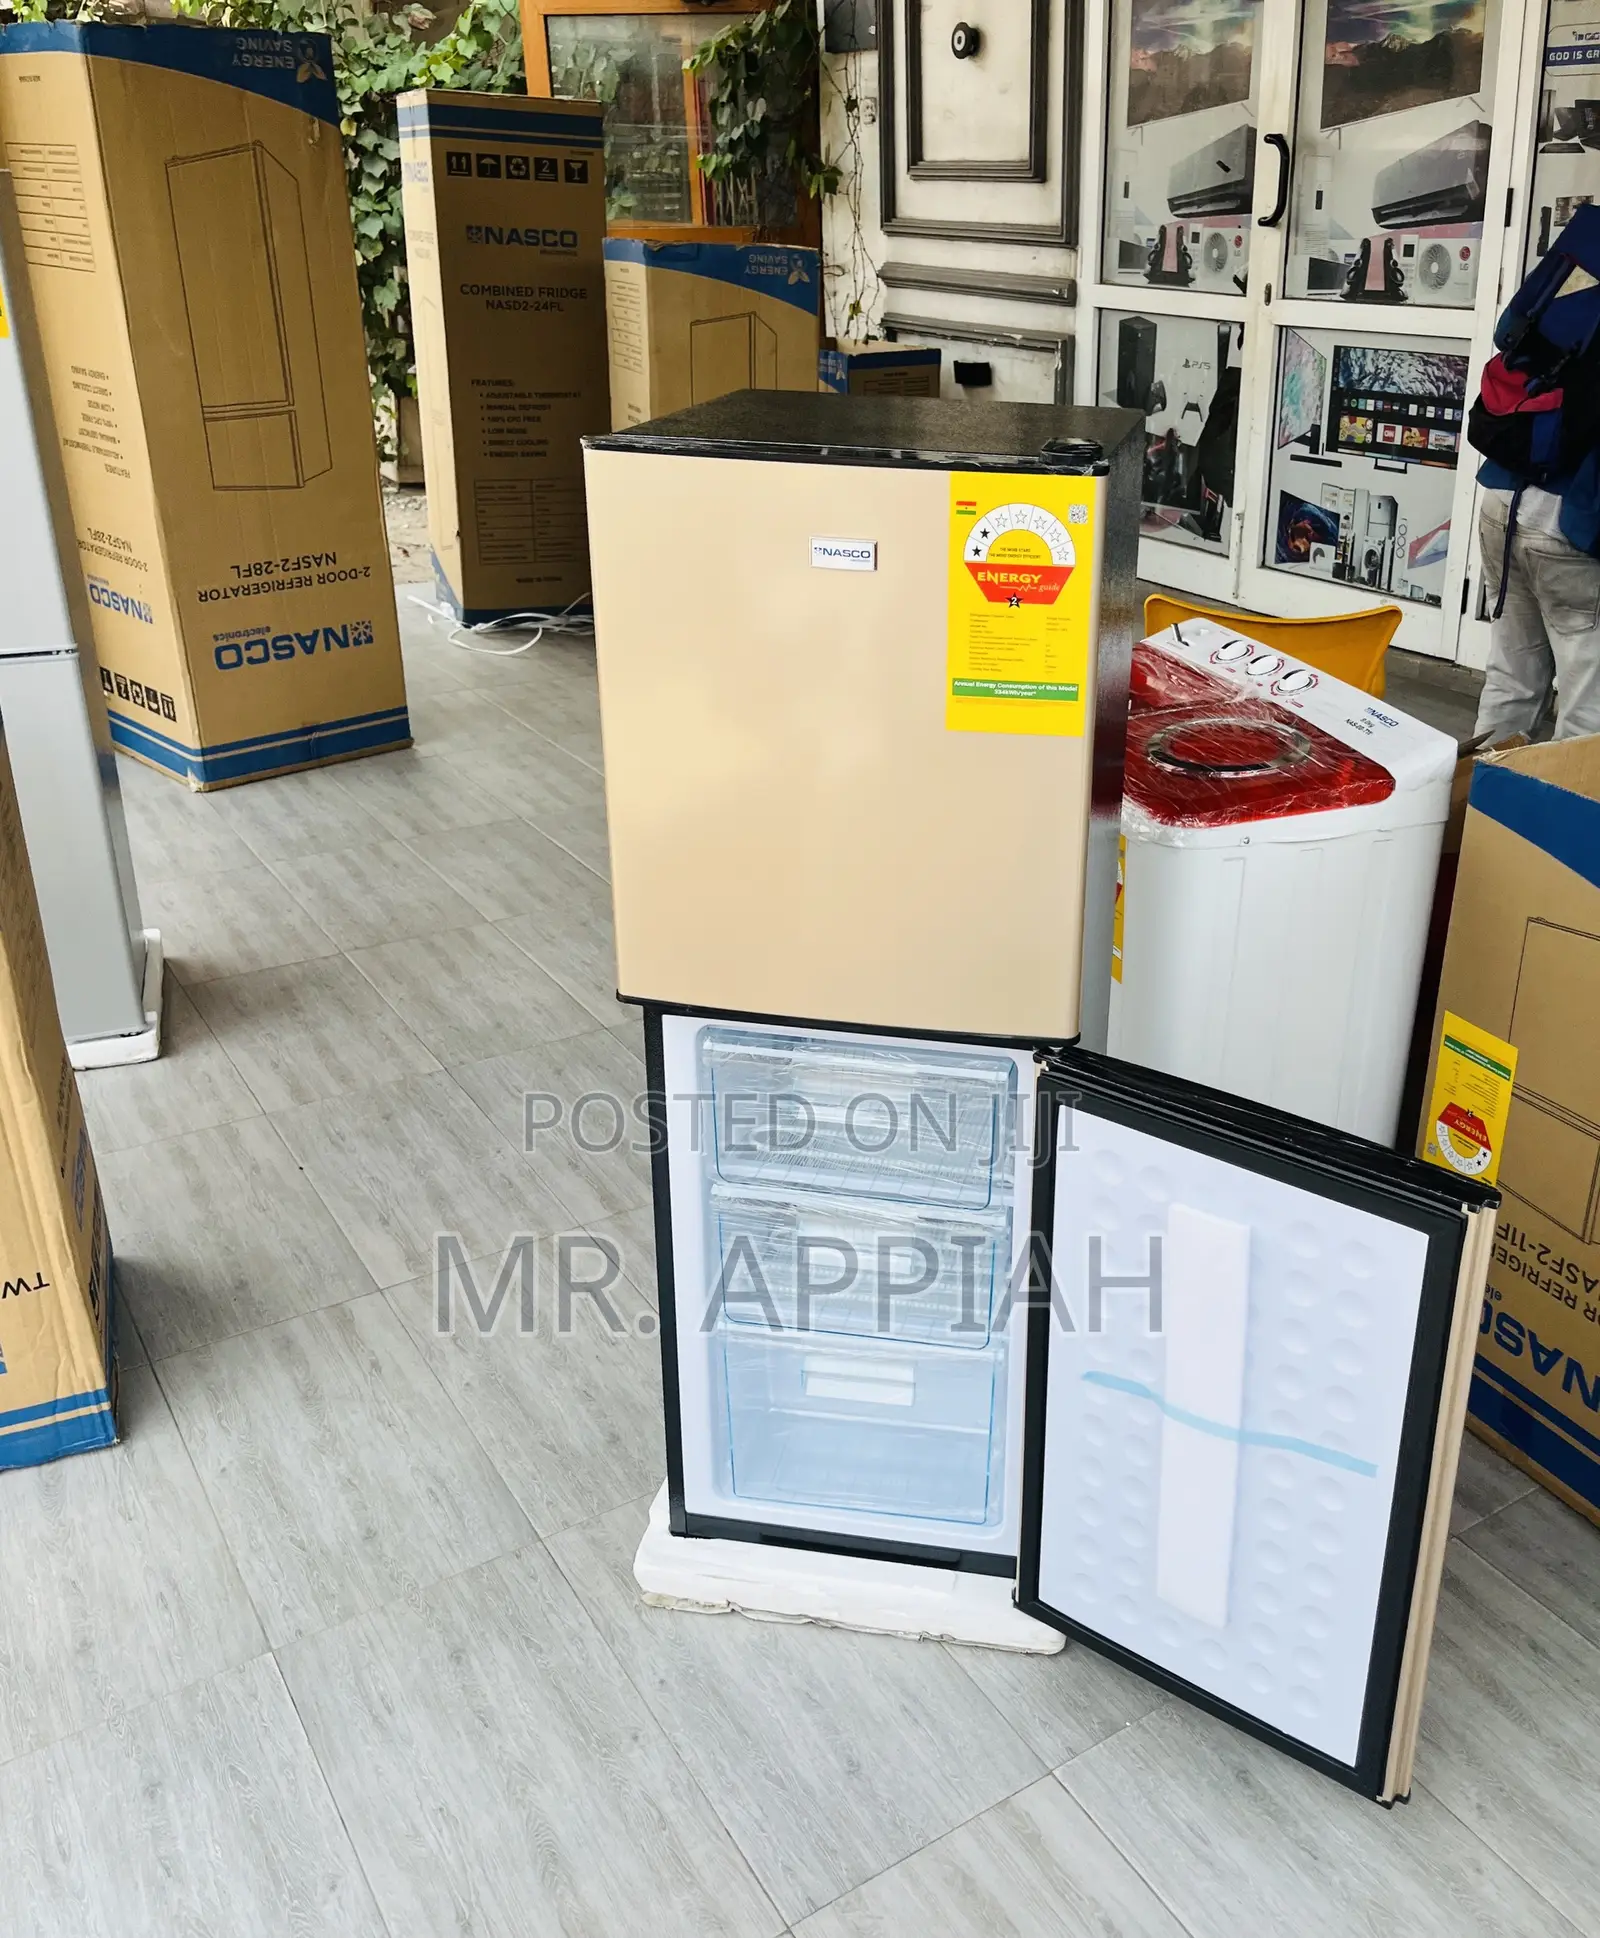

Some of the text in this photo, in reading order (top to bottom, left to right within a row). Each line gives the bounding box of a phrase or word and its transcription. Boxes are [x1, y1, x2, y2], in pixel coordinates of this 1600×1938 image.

[235, 37, 293, 53] SAVING
[232, 53, 295, 69] ENERGY
[1549, 51, 1570, 61] GOD
[1572, 50, 1582, 60] IS
[484, 226, 578, 249] NASCO
[748, 254, 789, 265] SAVING
[743, 264, 789, 276] ENERGY
[459, 283, 588, 299] COMBINED FRIDGE
[485, 300, 565, 312] NASD2-24FL
[822, 547, 871, 558] NASCO
[230, 551, 338, 580] NASF2-28FL
[198, 566, 371, 603] 2-DOOR REFRIGERATOR
[977, 570, 1042, 585] ENERGY
[88, 583, 144, 621] NASCO
[1011, 596, 1018, 605] 2
[213, 625, 271, 643] electronics
[213, 624, 351, 671] NASCO
[1370, 709, 1399, 728] NASCO
[1453, 1118, 1487, 1143] ENERGY
[1495, 1223, 1600, 1301] ASF2-11F
[1583, 1302, 1600, 1326] R
